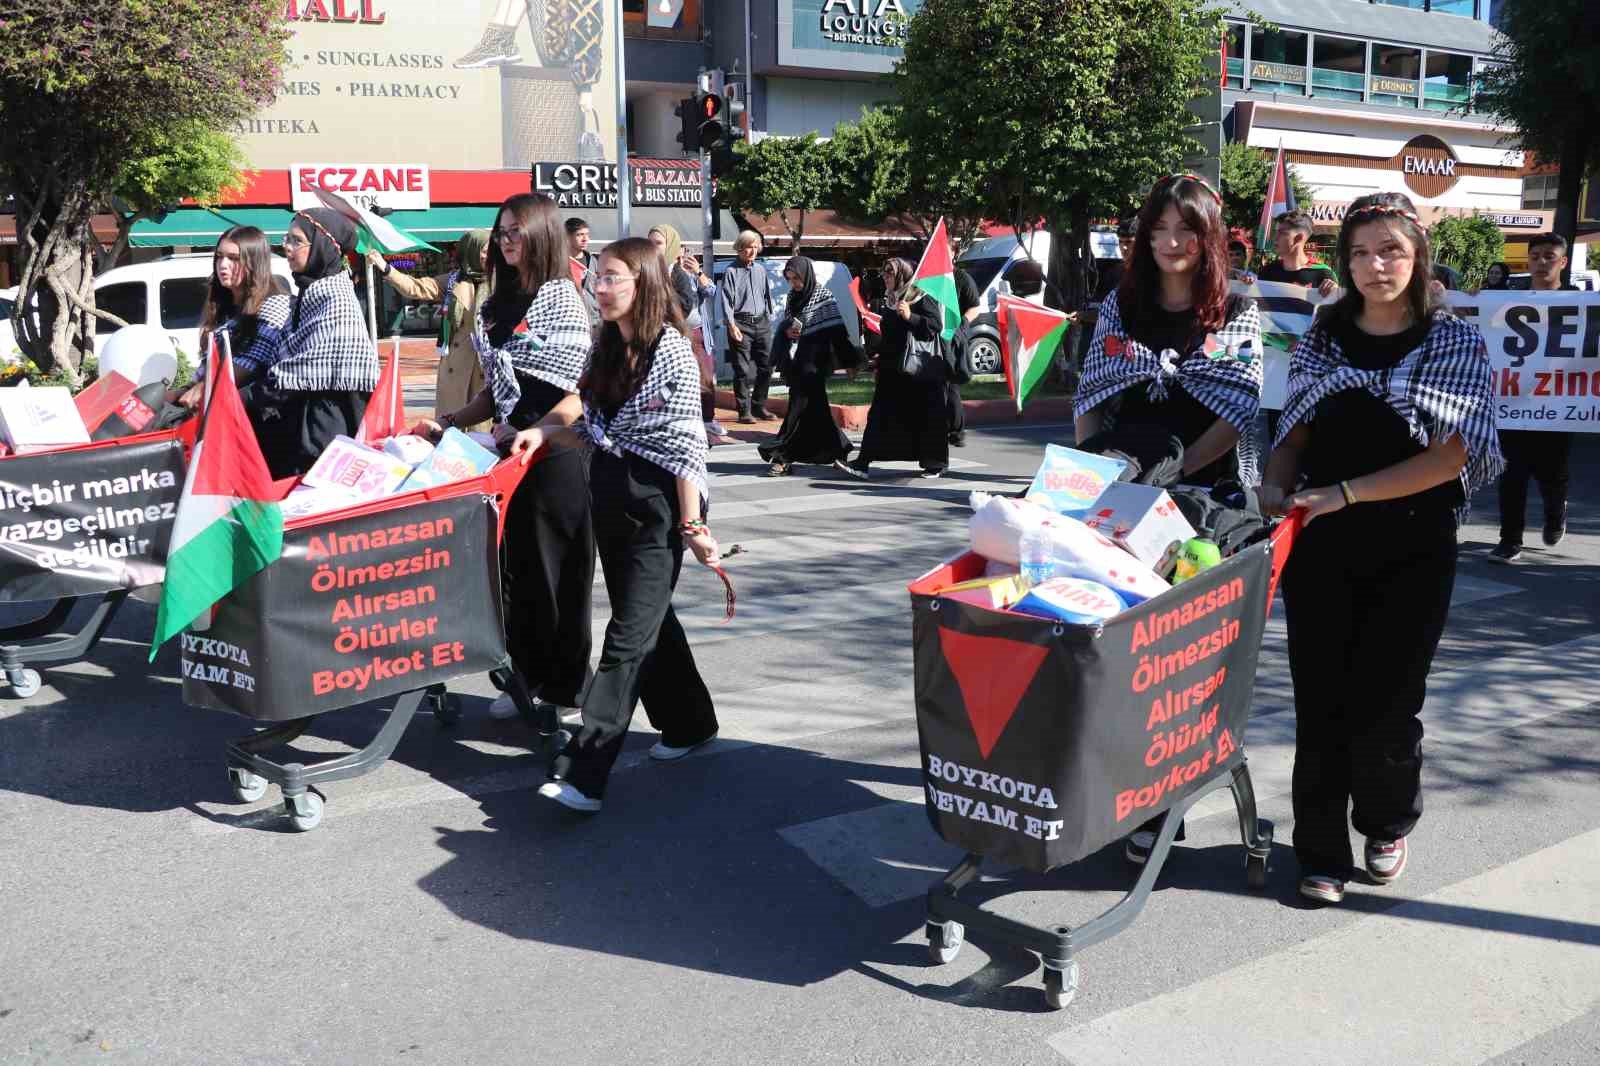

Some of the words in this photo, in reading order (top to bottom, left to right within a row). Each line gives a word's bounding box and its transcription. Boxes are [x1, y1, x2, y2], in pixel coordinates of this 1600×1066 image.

[317, 50, 444, 69] SUNGLASSES
[1252, 63, 1273, 79] ATA
[350, 82, 461, 99] PHARMACY
[299, 168, 423, 192] ECZANE
[644, 169, 702, 186] BAZAA
[1404, 155, 1455, 176] EMAAR
[646, 188, 665, 202] BUS
[667, 189, 703, 203] STATIO
[1498, 404, 1557, 420] Sende
[1564, 405, 1600, 421] Zul
[82, 468, 176, 499] marka
[35, 534, 149, 568] değildir
[305, 515, 455, 561] Almazsan
[311, 548, 450, 592] Ölmezsin
[331, 584, 436, 624] Alırsan
[1130, 576, 1244, 654] Almazsan
[181, 632, 251, 667] OYKOTA
[333, 616, 439, 654] Ölürler
[311, 650, 424, 697] Boykot
[431, 640, 465, 667] Et
[1131, 618, 1240, 693] Ölmezsin
[182, 657, 229, 685] VAM
[232, 670, 256, 692] ET
[1146, 666, 1227, 731] Alırsan
[928, 754, 1058, 809] BOYKOTA
[1115, 750, 1214, 823] Boykot
[927, 781, 1019, 831] DEVAM
[1024, 815, 1064, 841] ET
